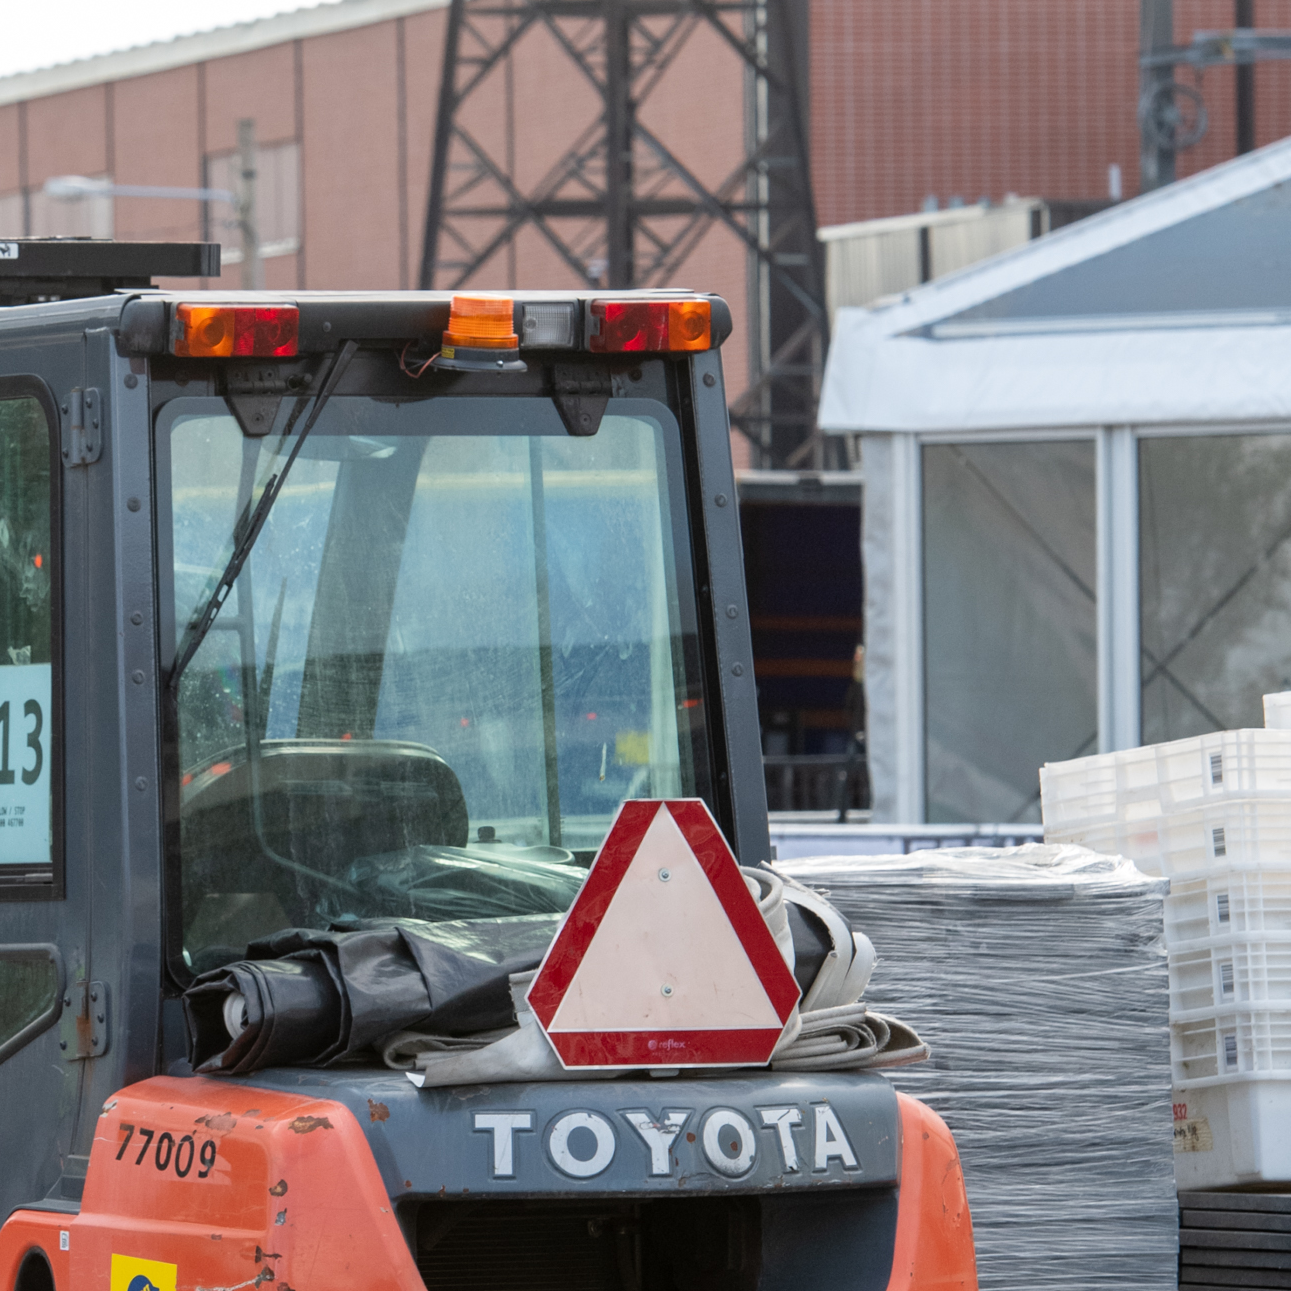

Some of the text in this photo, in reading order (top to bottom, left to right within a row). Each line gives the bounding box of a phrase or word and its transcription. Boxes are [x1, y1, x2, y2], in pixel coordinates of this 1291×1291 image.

[659, 1039, 686, 1051] reflex
[115, 1122, 217, 1179] 77009
[474, 1105, 858, 1178] TOYOTA
